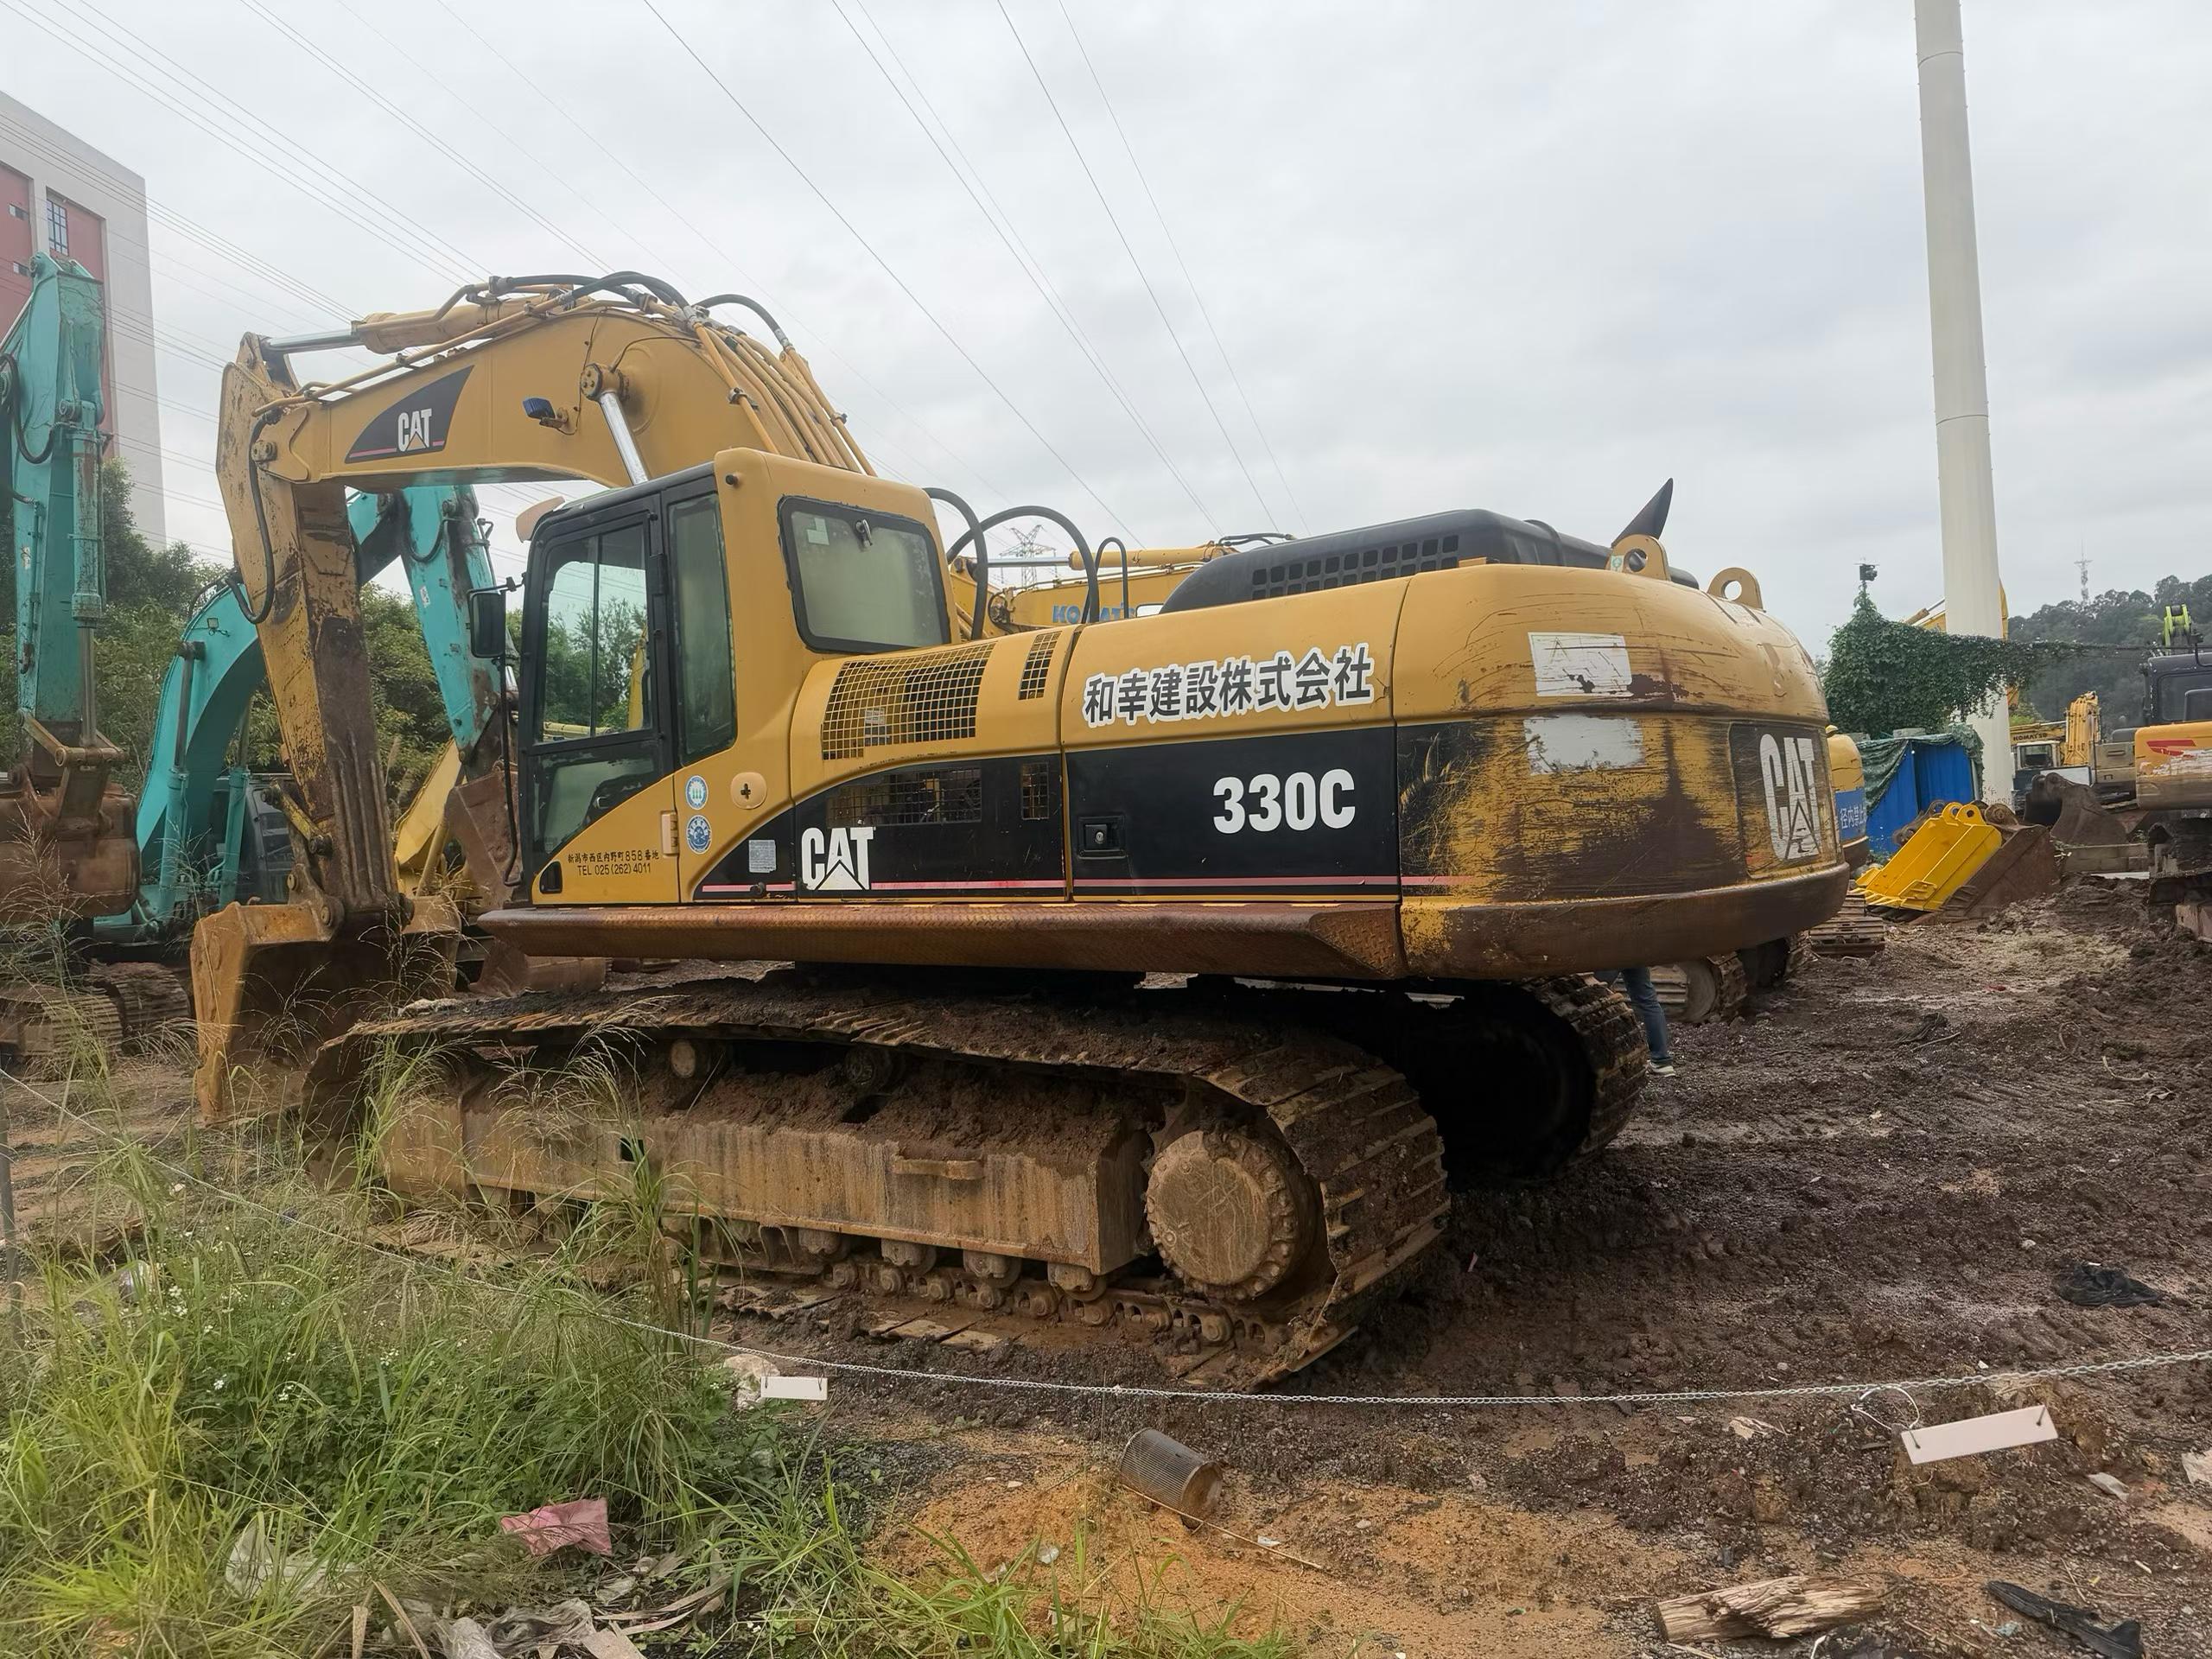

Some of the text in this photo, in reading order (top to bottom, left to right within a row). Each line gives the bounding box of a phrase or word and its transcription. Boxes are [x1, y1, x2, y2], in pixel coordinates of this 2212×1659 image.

[397, 408, 432, 452] CAT
[1084, 644, 1374, 726] 和幸建設株式会社
[1213, 768, 1356, 834] 330C
[1759, 734, 1821, 861] CAT
[577, 865, 592, 875] TEL
[801, 826, 874, 891] CAT
